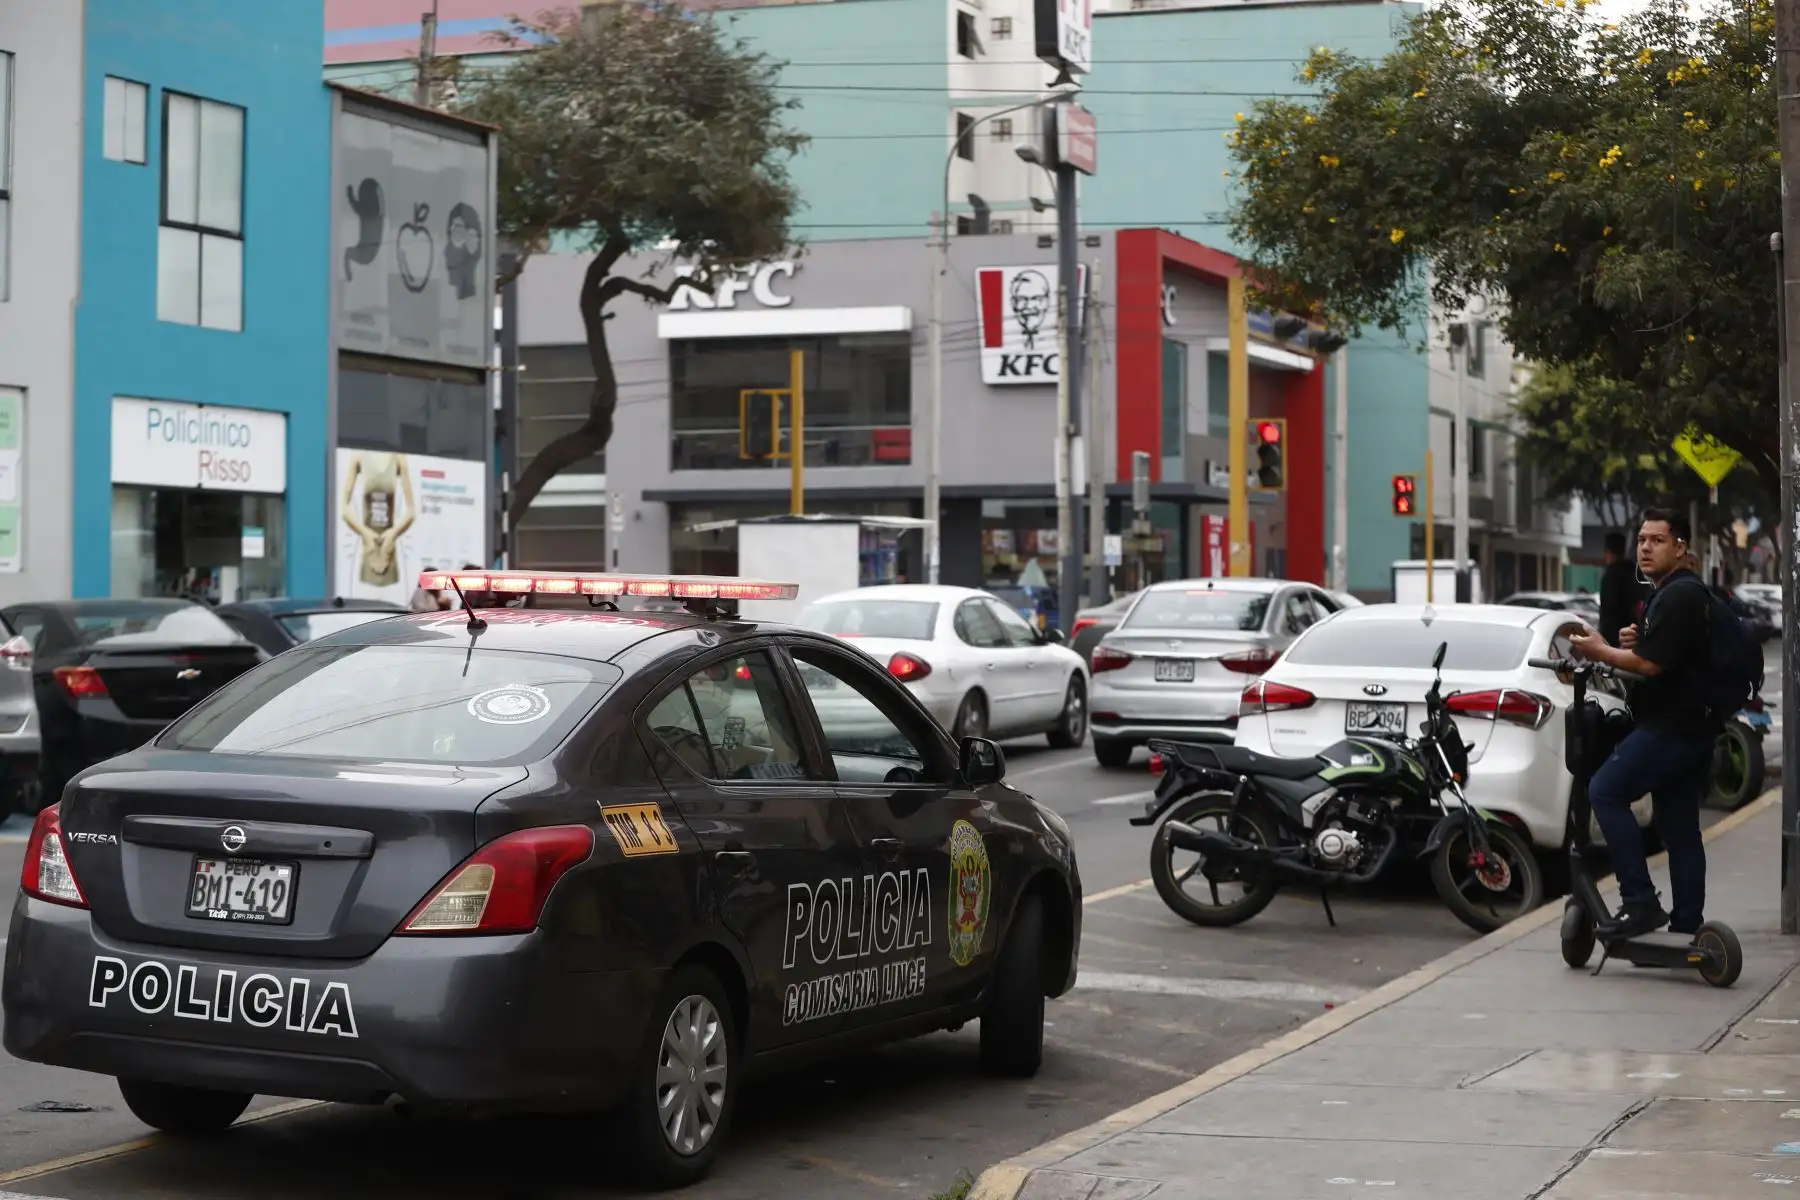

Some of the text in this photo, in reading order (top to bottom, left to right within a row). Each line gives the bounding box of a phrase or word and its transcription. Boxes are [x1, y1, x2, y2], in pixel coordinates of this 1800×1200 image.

[199, 450, 251, 482] Risso
[1365, 684, 1384, 694] KIA
[68, 832, 118, 846] VERSA
[224, 862, 261, 877] PERU
[192, 873, 287, 913] BMI-419
[782, 868, 932, 969] POLICIA
[89, 956, 359, 1038] POLICIA
[782, 957, 926, 1026] COMISARIA LINCE
